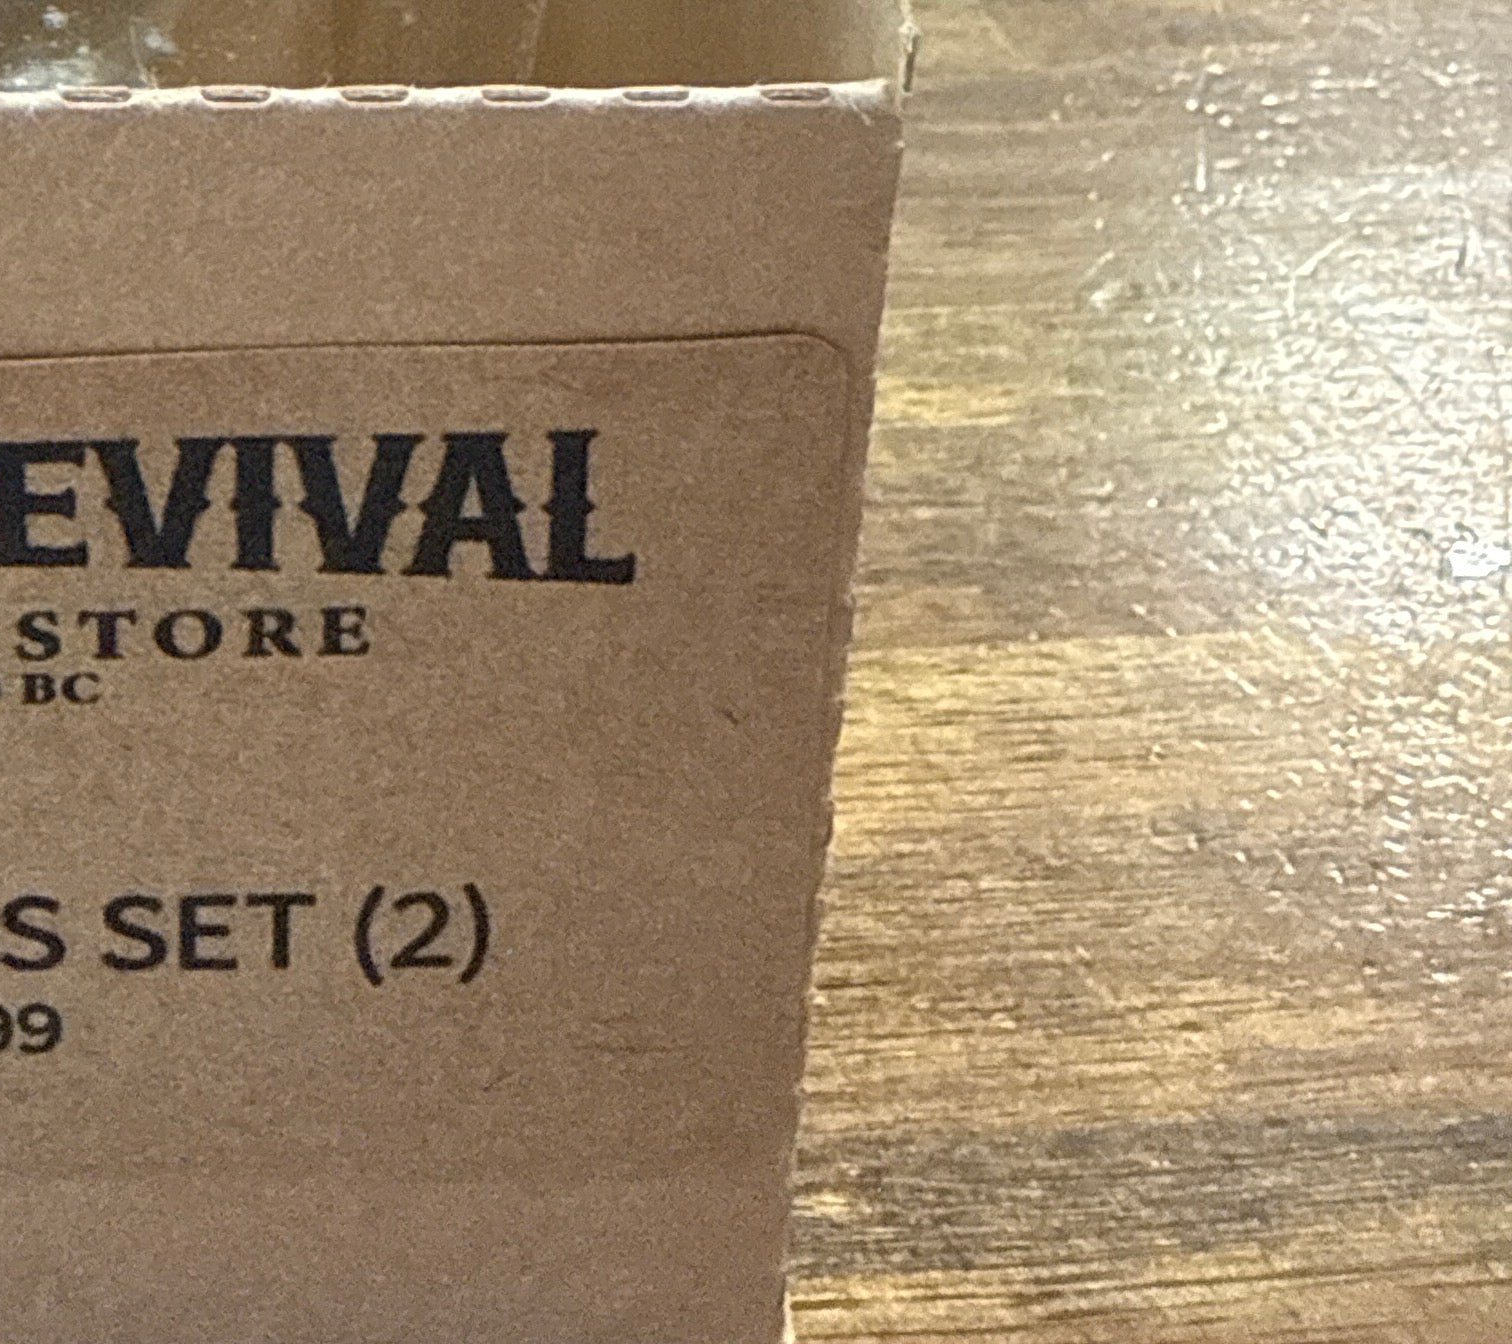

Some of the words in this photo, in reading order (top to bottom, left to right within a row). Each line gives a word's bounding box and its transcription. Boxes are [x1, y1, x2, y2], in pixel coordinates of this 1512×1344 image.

[14, 605, 372, 662] STORE
[20, 672, 102, 707] BC
[99, 891, 317, 973] SET
[352, 883, 491, 988] (2)
